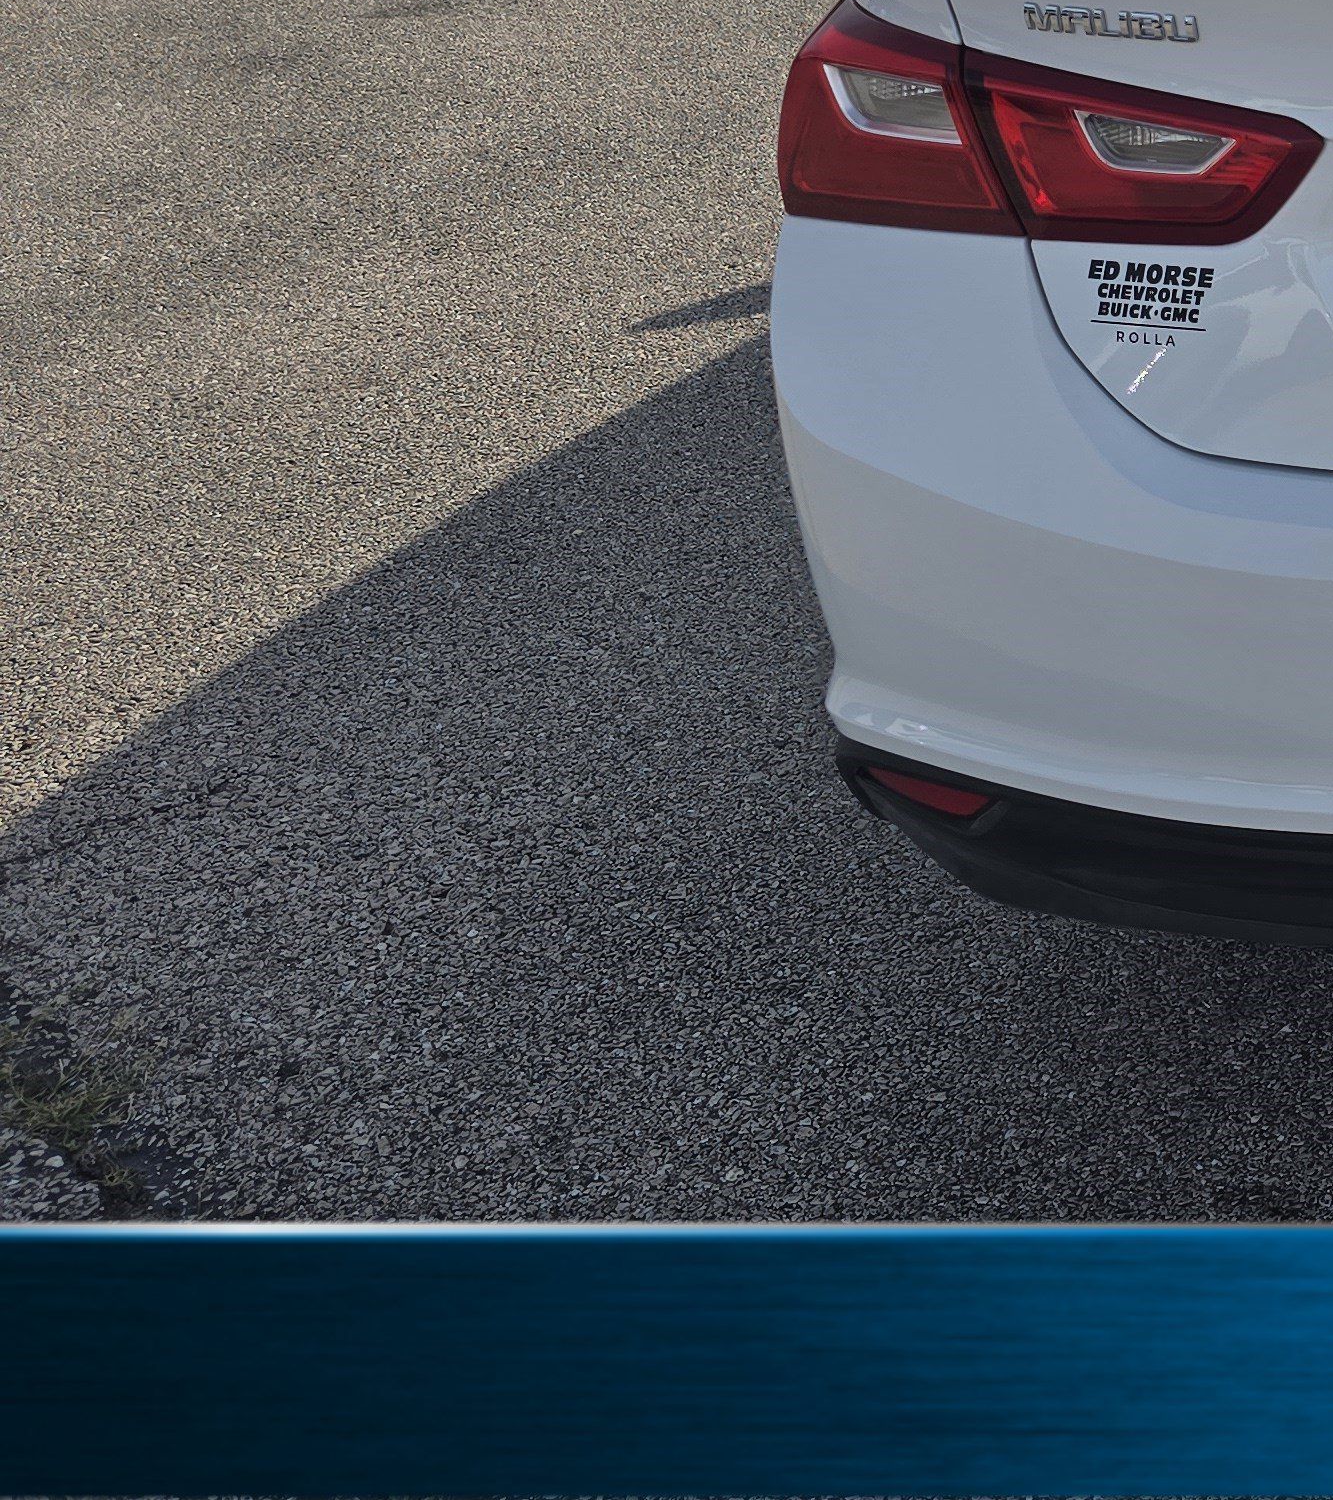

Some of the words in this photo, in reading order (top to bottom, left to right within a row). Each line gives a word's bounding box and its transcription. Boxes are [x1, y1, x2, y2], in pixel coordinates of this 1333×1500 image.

[1023, 1, 1200, 42] MALIBU
[1088, 259, 1121, 281] ED
[1124, 261, 1215, 289] MORSE
[1097, 283, 1205, 306] CHEVROLET
[1116, 330, 1176, 348] ROLLA
